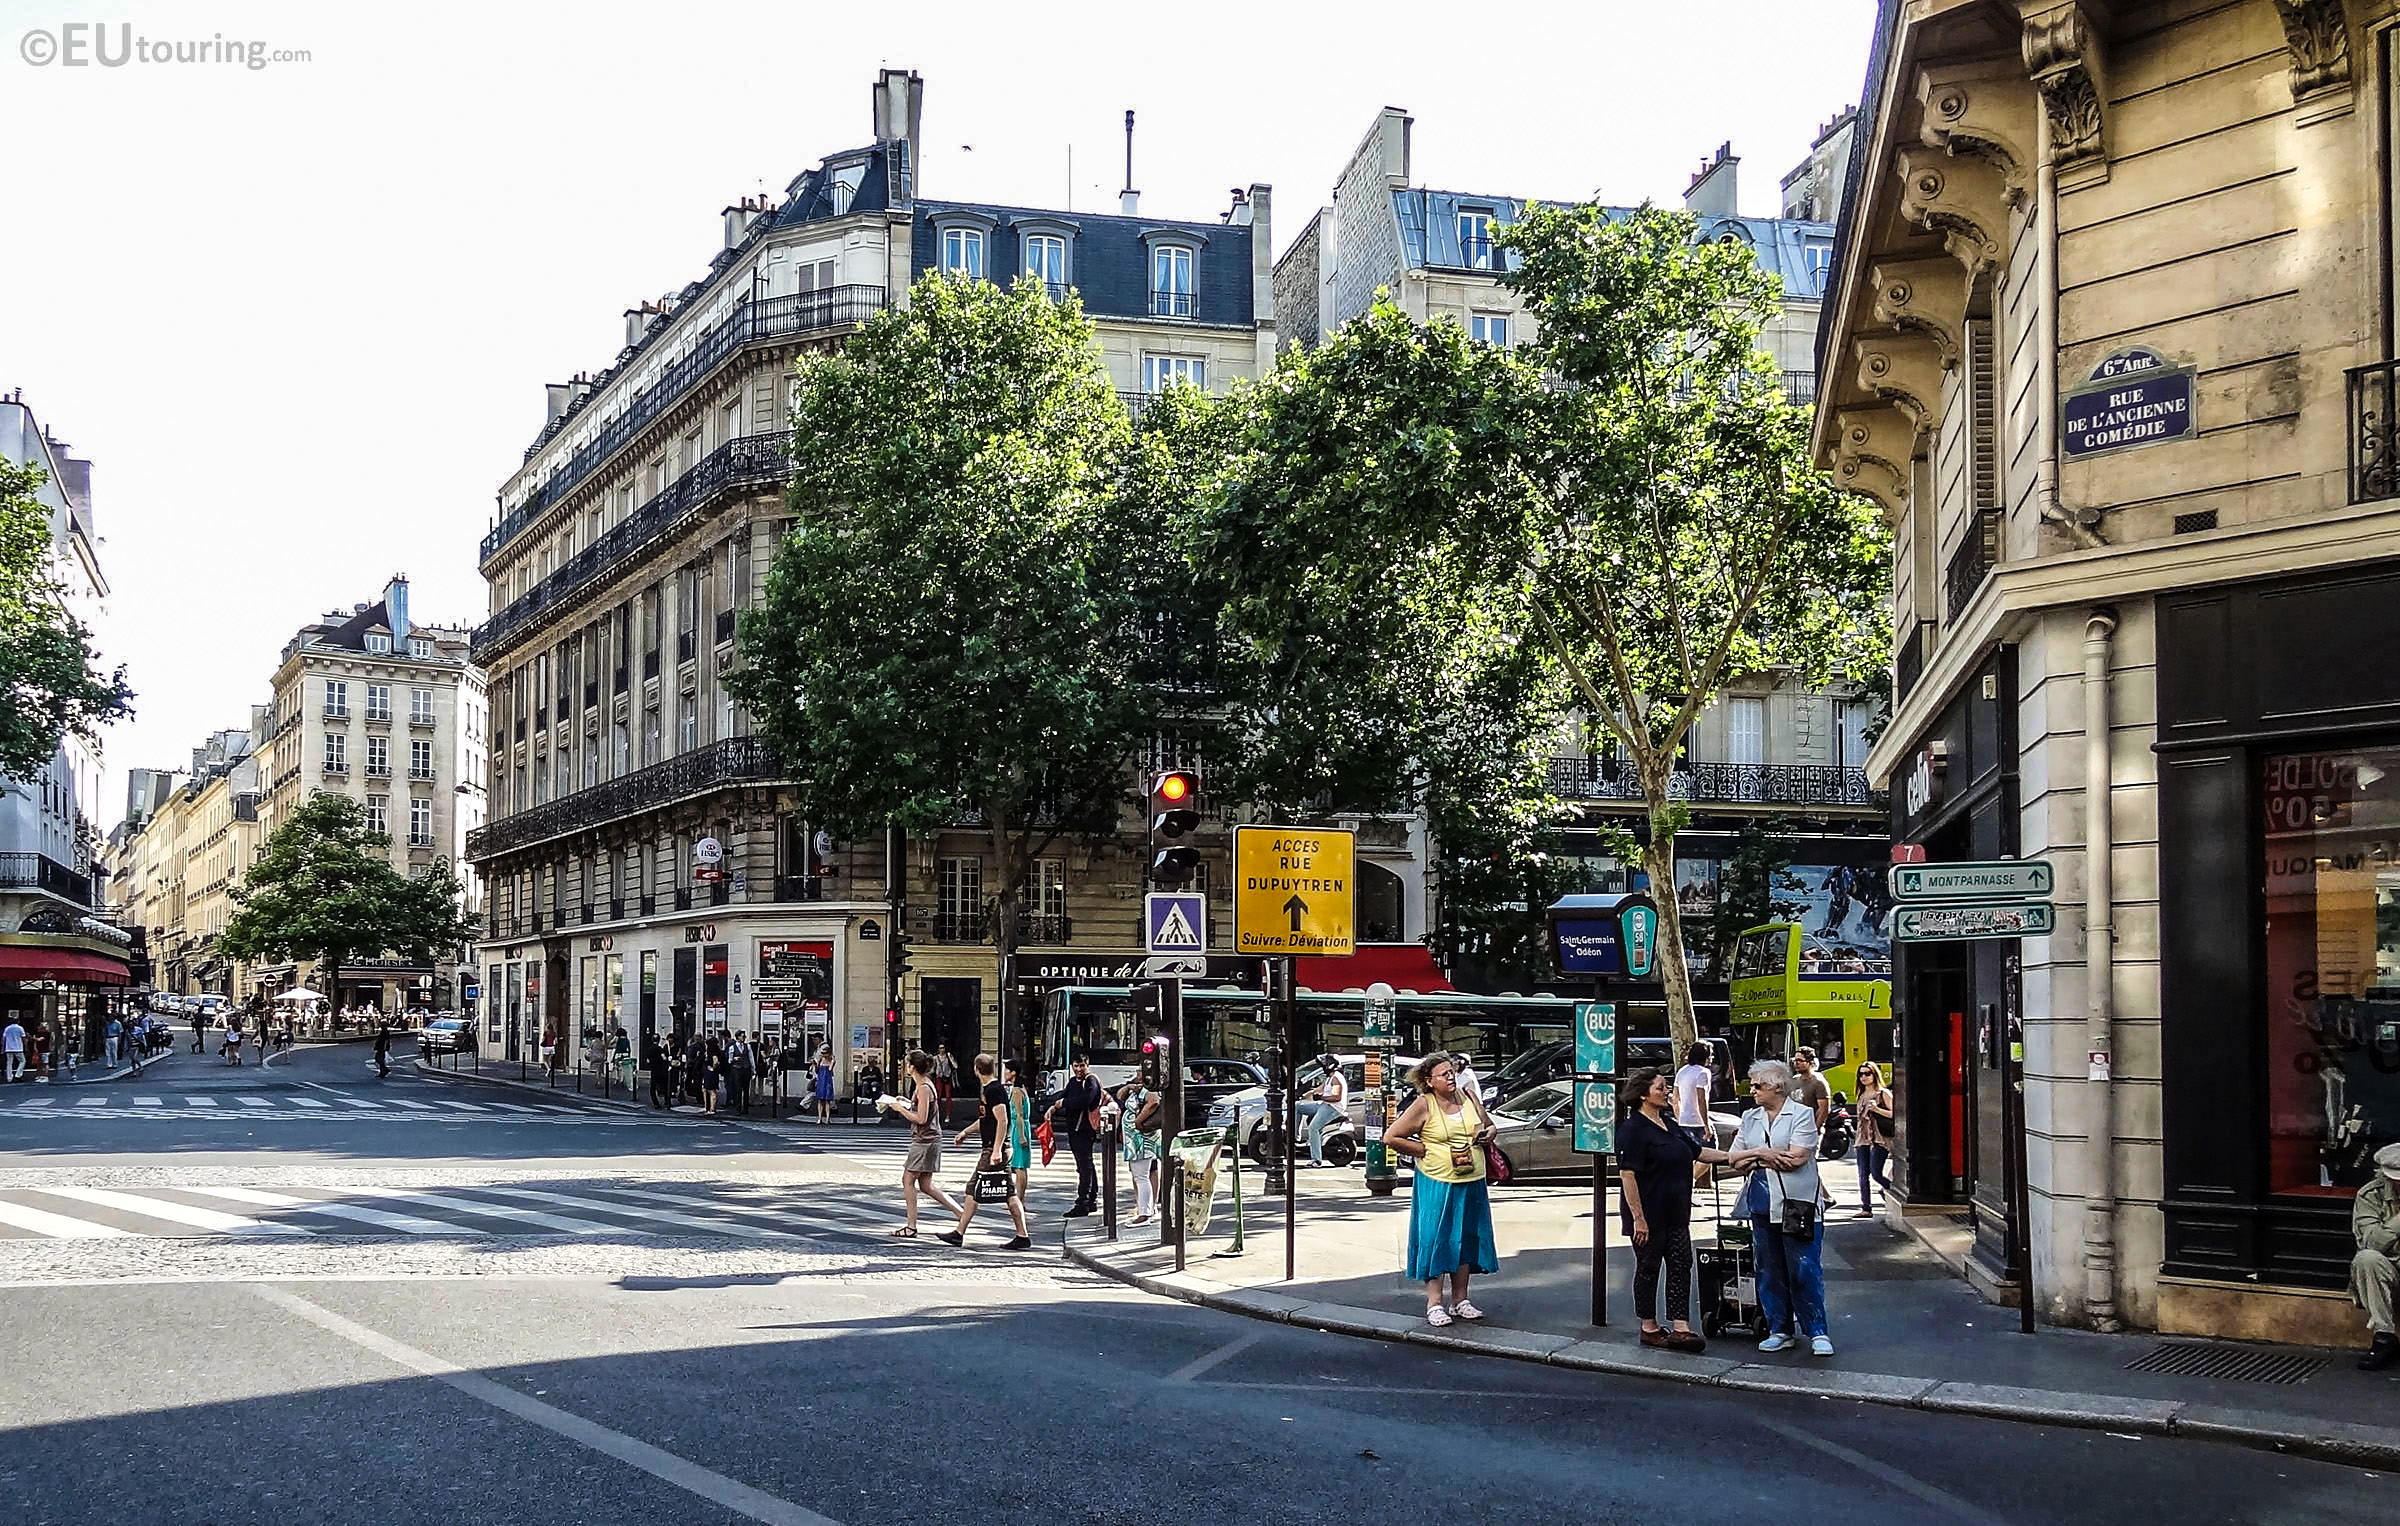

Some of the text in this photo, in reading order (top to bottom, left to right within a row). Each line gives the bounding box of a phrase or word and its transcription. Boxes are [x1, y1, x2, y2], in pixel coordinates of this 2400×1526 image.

[2109, 389, 2144, 408] RUE
[2067, 398, 2186, 434] DE L'ANCIENNE
[2084, 420, 2166, 447] COMÉDIE
[1272, 839, 1320, 853] ACCES
[1904, 845, 1914, 862] 7
[1280, 856, 1311, 870] RUE
[1247, 877, 1343, 892] DUPUYTREN
[1928, 874, 2015, 888] MONTPARNASSE
[1241, 932, 1348, 947] Suivre: Déviation
[1560, 936, 1615, 945] Saint-Germain
[1576, 948, 1602, 956] Odéon
[1040, 966, 1109, 977] OPTIQUE
[1114, 962, 1132, 977] de
[1589, 1014, 1615, 1030] BUS
[1588, 1092, 1615, 1109] BUS
[981, 1186, 1008, 1195] PHARE
